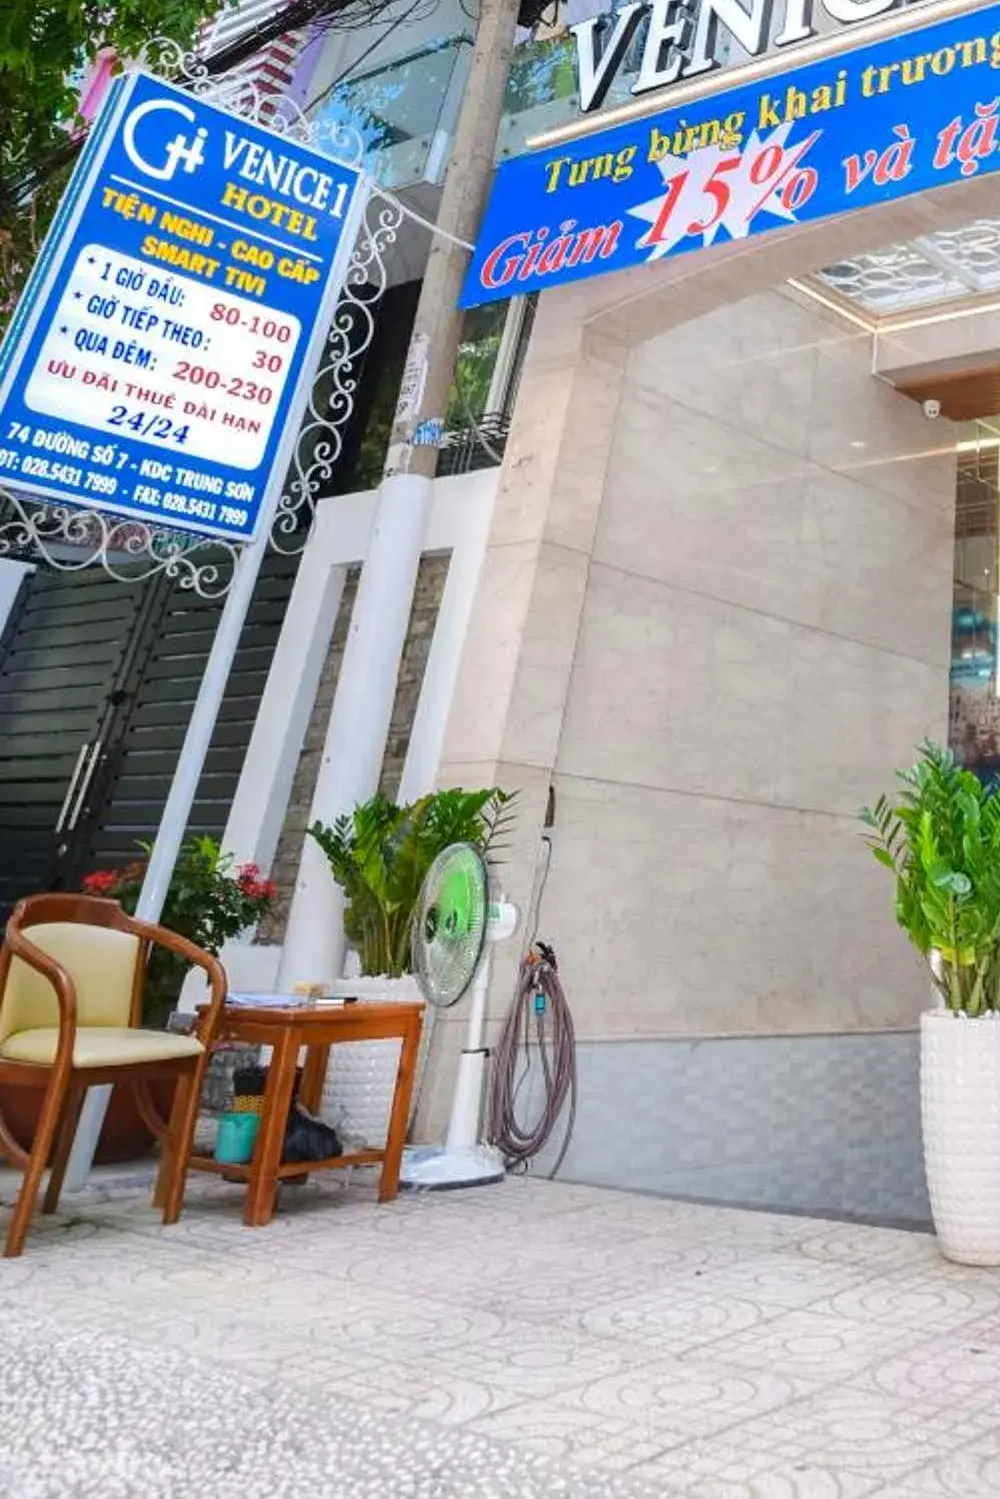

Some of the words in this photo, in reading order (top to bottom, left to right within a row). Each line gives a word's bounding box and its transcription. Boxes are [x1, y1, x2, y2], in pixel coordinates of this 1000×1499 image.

[545, 142, 638, 193] Tưng
[648, 110, 747, 162] bừng
[758, 70, 848, 130] khai
[102, 187, 157, 225] TIỆN
[159, 211, 215, 248] NGHI
[231, 239, 275, 269] CAO
[277, 259, 320, 285] CẤP
[221, 181, 319, 240] HOTEL
[479, 218, 624, 289] Giảm
[641, 128, 824, 247] 15%
[842, 124, 916, 194] và
[100, 262, 112, 281] 1
[115, 266, 147, 291] GIỜ
[209, 302, 292, 343] 80-100
[141, 236, 221, 279] SMART
[225, 266, 268, 297] TIVI
[73, 327, 109, 354] QUA
[172, 360, 273, 405] 200-230
[87, 293, 119, 319] GIỜ
[121, 304, 158, 333] TIẾP
[251, 350, 283, 373] 30
[47, 359, 77, 379] ƯU
[81, 369, 118, 393] ĐÃI
[183, 400, 217, 422] DÀI
[221, 411, 262, 435] HẠN
[106, 405, 190, 445] 24/24
[6, 421, 30, 443] 74
[91, 443, 119, 466] SỐ
[115, 453, 129, 469] 7
[139, 458, 172, 482] KDC
[175, 467, 223, 495] TRUNG
[83, 471, 118, 496] 7999
